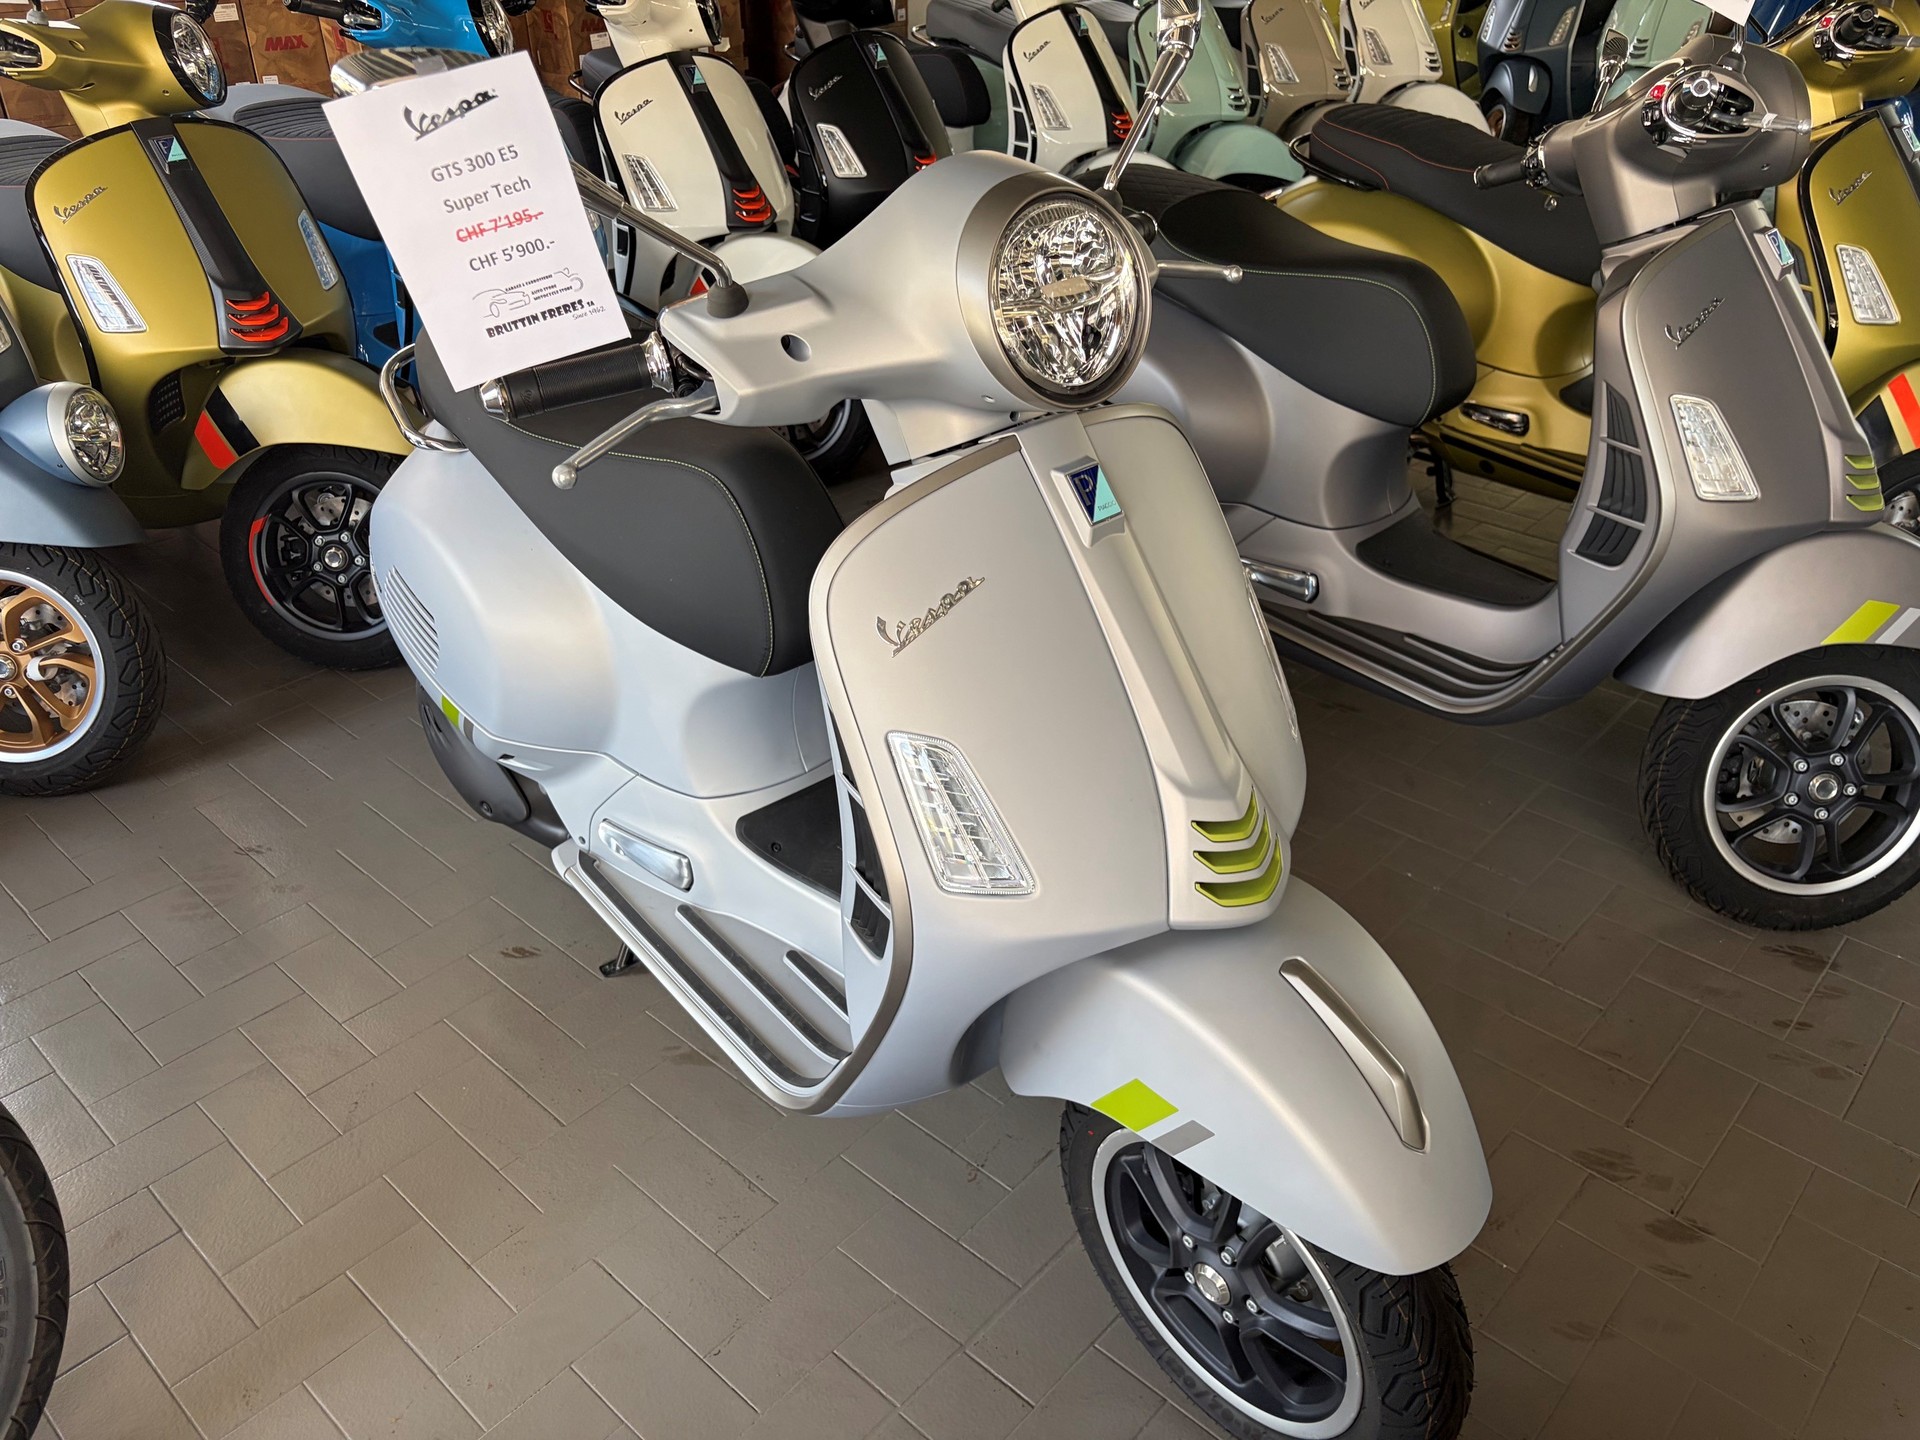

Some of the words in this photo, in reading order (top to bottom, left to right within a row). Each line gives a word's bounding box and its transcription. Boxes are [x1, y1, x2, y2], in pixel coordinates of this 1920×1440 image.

[265, 34, 309, 52] MAX
[403, 91, 499, 141] Vespa
[614, 99, 654, 125] Vespa
[431, 161, 463, 182] GTS
[464, 152, 496, 173] 300
[498, 144, 519, 162] E5
[54, 186, 108, 225] Vespa
[443, 190, 489, 213] Super
[491, 176, 532, 198] Tech
[1828, 170, 1873, 206] Vespa
[455, 222, 487, 242] CHF
[469, 252, 499, 271] CHF
[485, 313, 541, 338] BRUTTIN
[539, 299, 585, 322] FRERES
[1664, 297, 1726, 351] Vespa
[876, 576, 986, 659] Vespa
